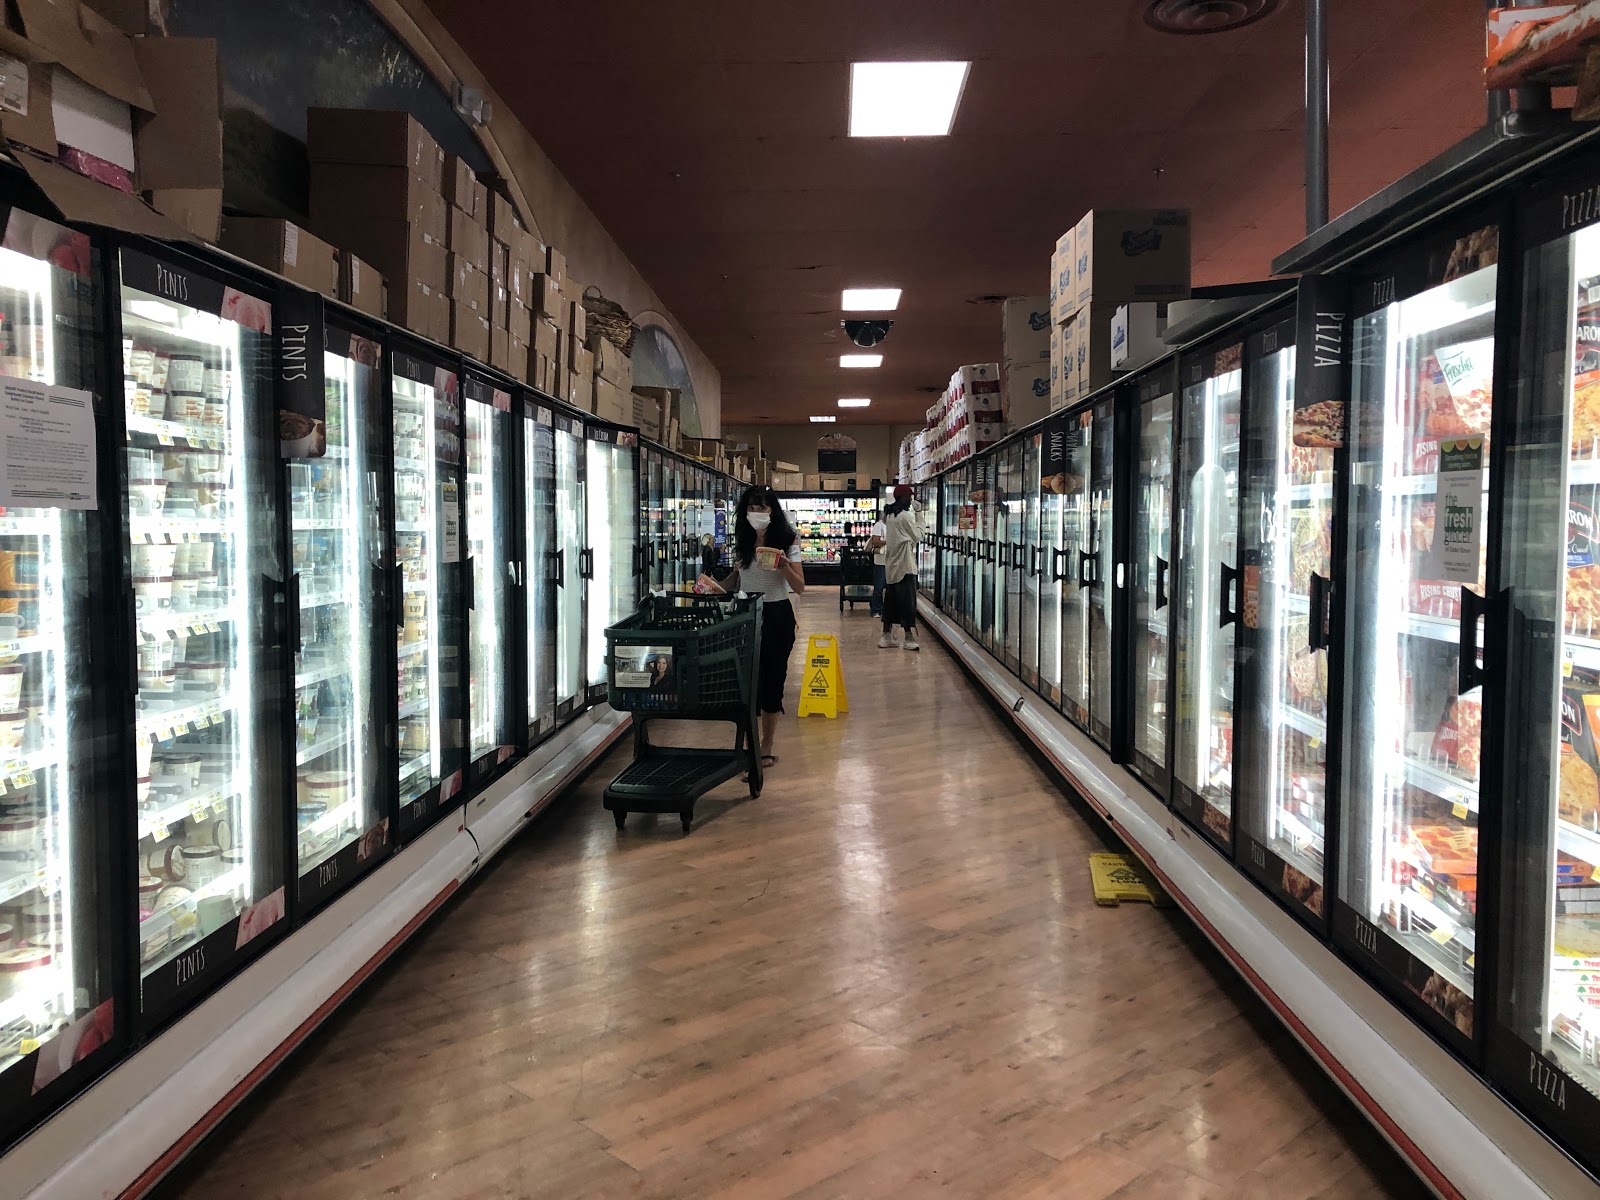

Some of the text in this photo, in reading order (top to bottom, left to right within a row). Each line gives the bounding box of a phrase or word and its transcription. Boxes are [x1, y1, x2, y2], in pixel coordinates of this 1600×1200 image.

[156, 263, 188, 301] PINTS
[1372, 276, 1395, 308] PIZZA
[282, 324, 310, 382] PINTS
[1262, 330, 1278, 354] PIZZA
[1314, 312, 1346, 368] PIZZA
[406, 358, 421, 380] PINTS
[1050, 431, 1064, 462] SNACKS
[1446, 492, 1458, 507] the
[1444, 510, 1473, 529] fresh
[1444, 530, 1472, 545] grocer
[1420, 584, 1462, 601] RISING CRUST
[319, 858, 338, 888] PINTS
[1355, 915, 1377, 954] PIZZA
[176, 945, 206, 986] PINTS
[1530, 1051, 1566, 1110] PIZZA
